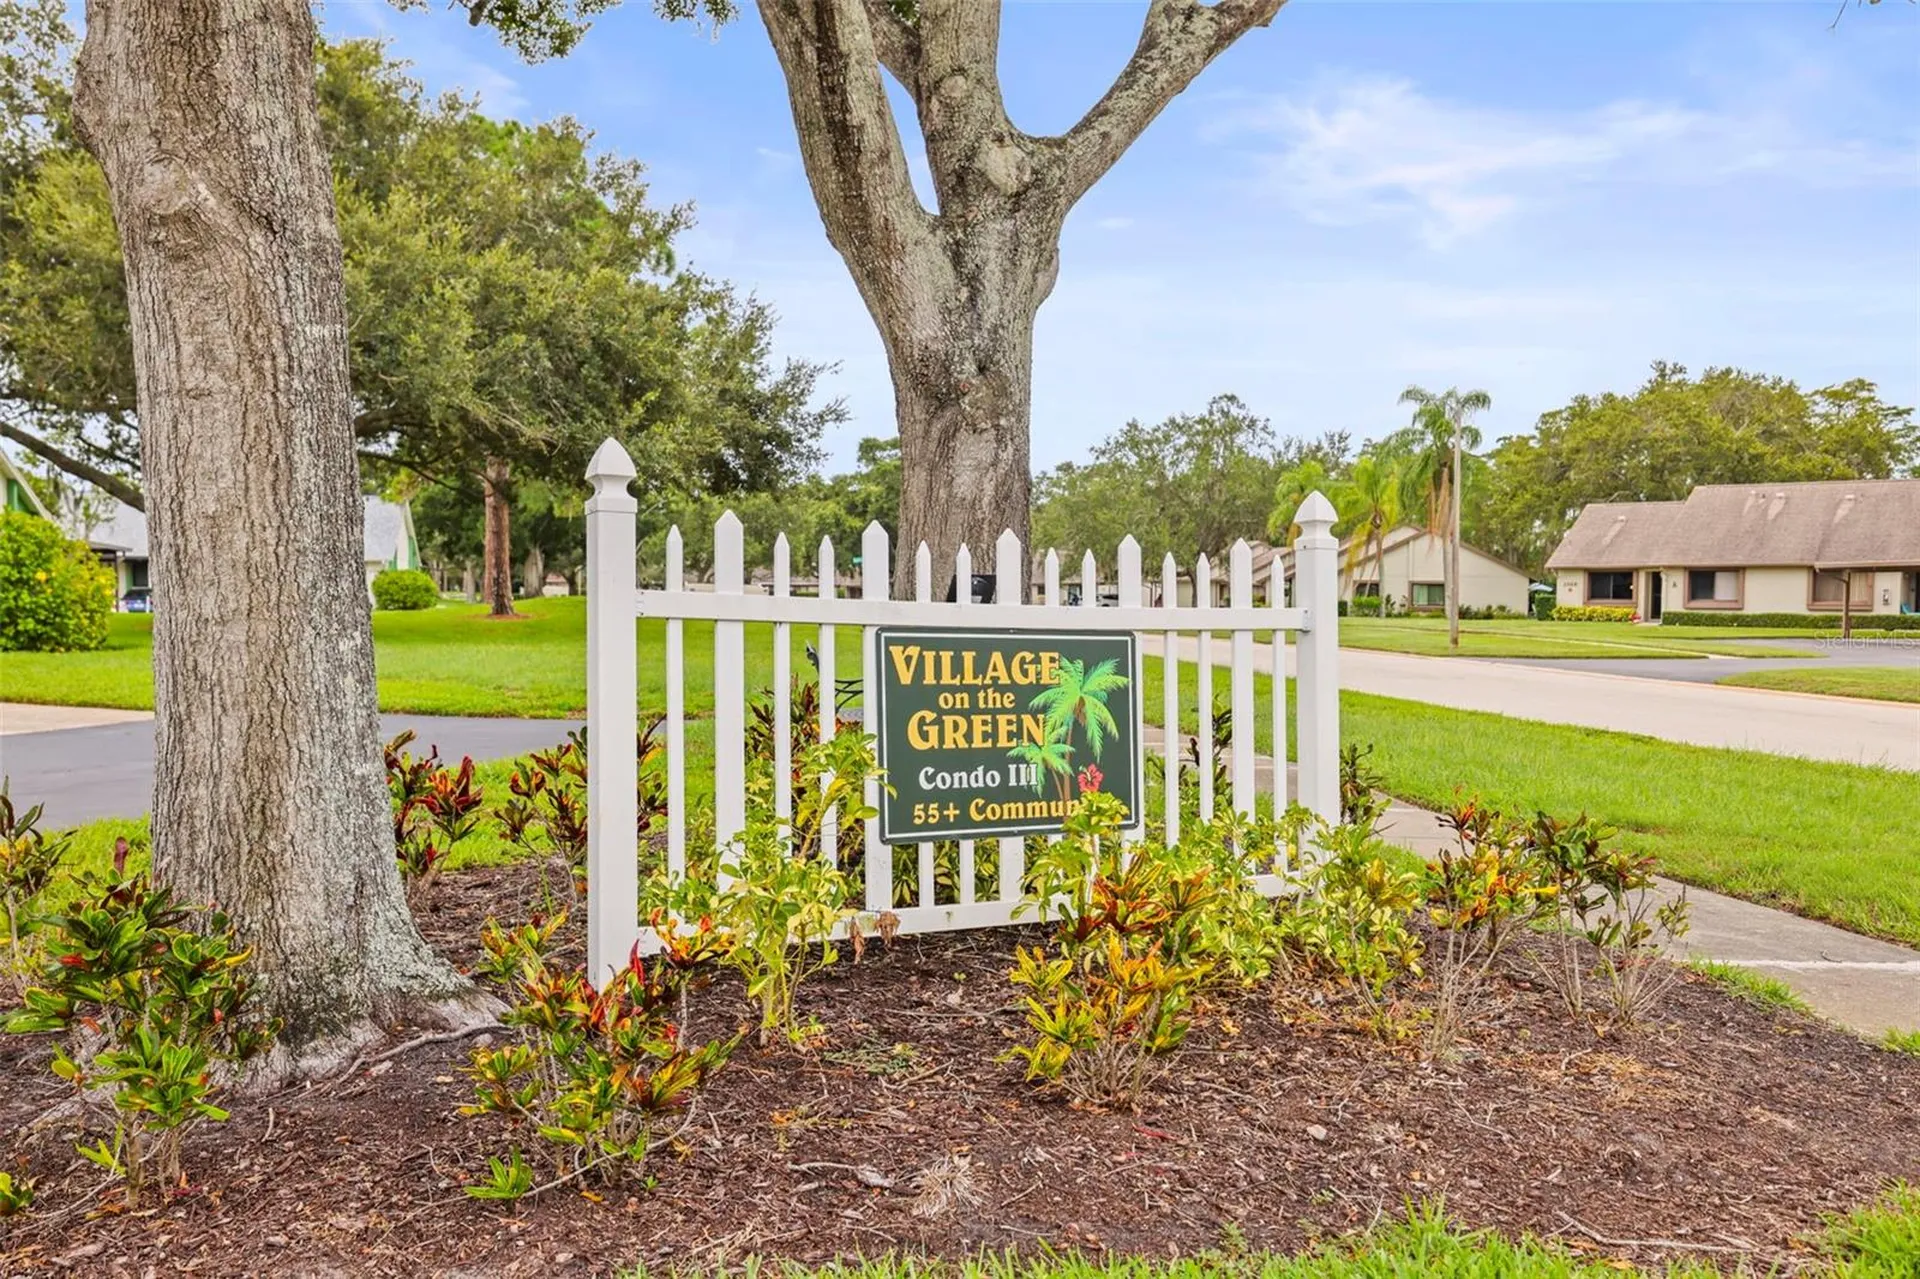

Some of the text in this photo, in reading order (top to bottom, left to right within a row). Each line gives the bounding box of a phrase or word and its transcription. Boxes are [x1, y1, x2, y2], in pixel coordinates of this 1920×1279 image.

[888, 645, 1060, 686] VILLAGE
[938, 687, 1016, 709] on the
[907, 709, 1046, 751] GREEN
[918, 763, 1038, 791] Condo III
[912, 798, 1080, 825] 55+ Commun
